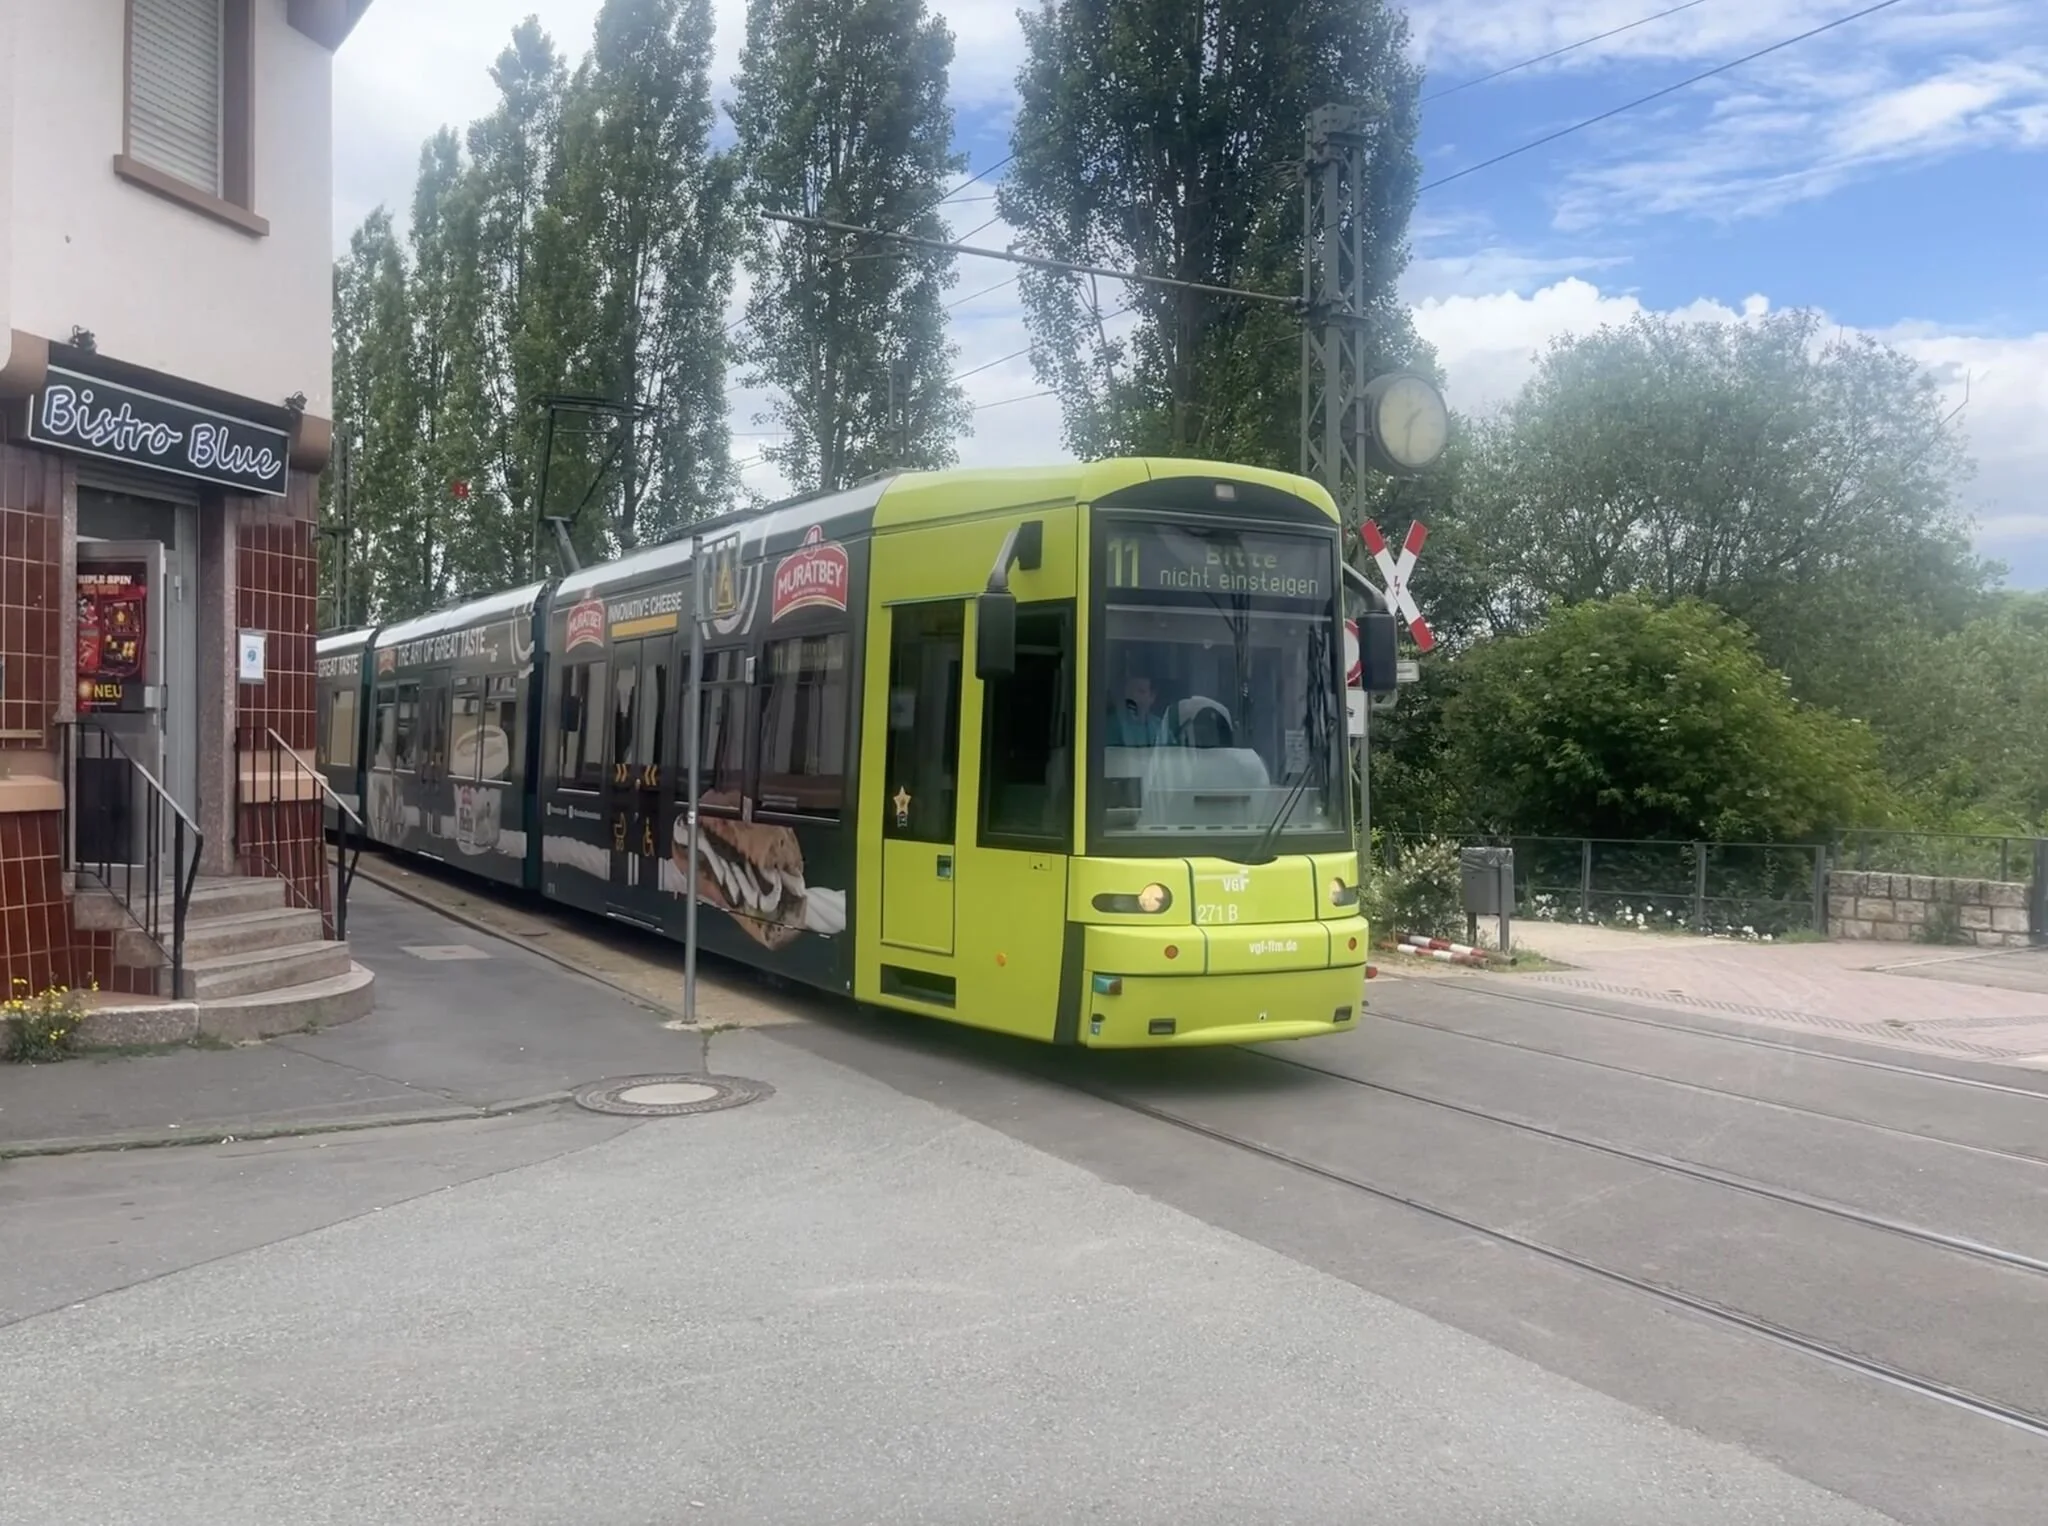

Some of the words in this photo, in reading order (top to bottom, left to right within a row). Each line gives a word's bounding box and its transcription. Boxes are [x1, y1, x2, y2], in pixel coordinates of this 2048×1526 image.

[42, 385, 182, 454] Bistro
[188, 423, 282, 480] Blue
[1108, 537, 1139, 588] 11
[1206, 544, 1277, 568] Bitte
[77, 575, 105, 584] RIPLE
[107, 574, 131, 585] SPIN
[777, 559, 844, 600] MURATBEY
[1160, 567, 1210, 589] nicht
[1219, 572, 1318, 597] einsteigen
[650, 591, 682, 615] CHEESE
[410, 640, 423, 665] ART
[423, 638, 434, 663] OF
[434, 632, 459, 661] GREAT
[318, 656, 338, 677] GREAT
[339, 654, 358, 675] TASTE
[94, 684, 122, 698] NEU
[1223, 870, 1250, 892] VGF
[1198, 904, 1222, 923] 271
[1228, 903, 1238, 922] B
